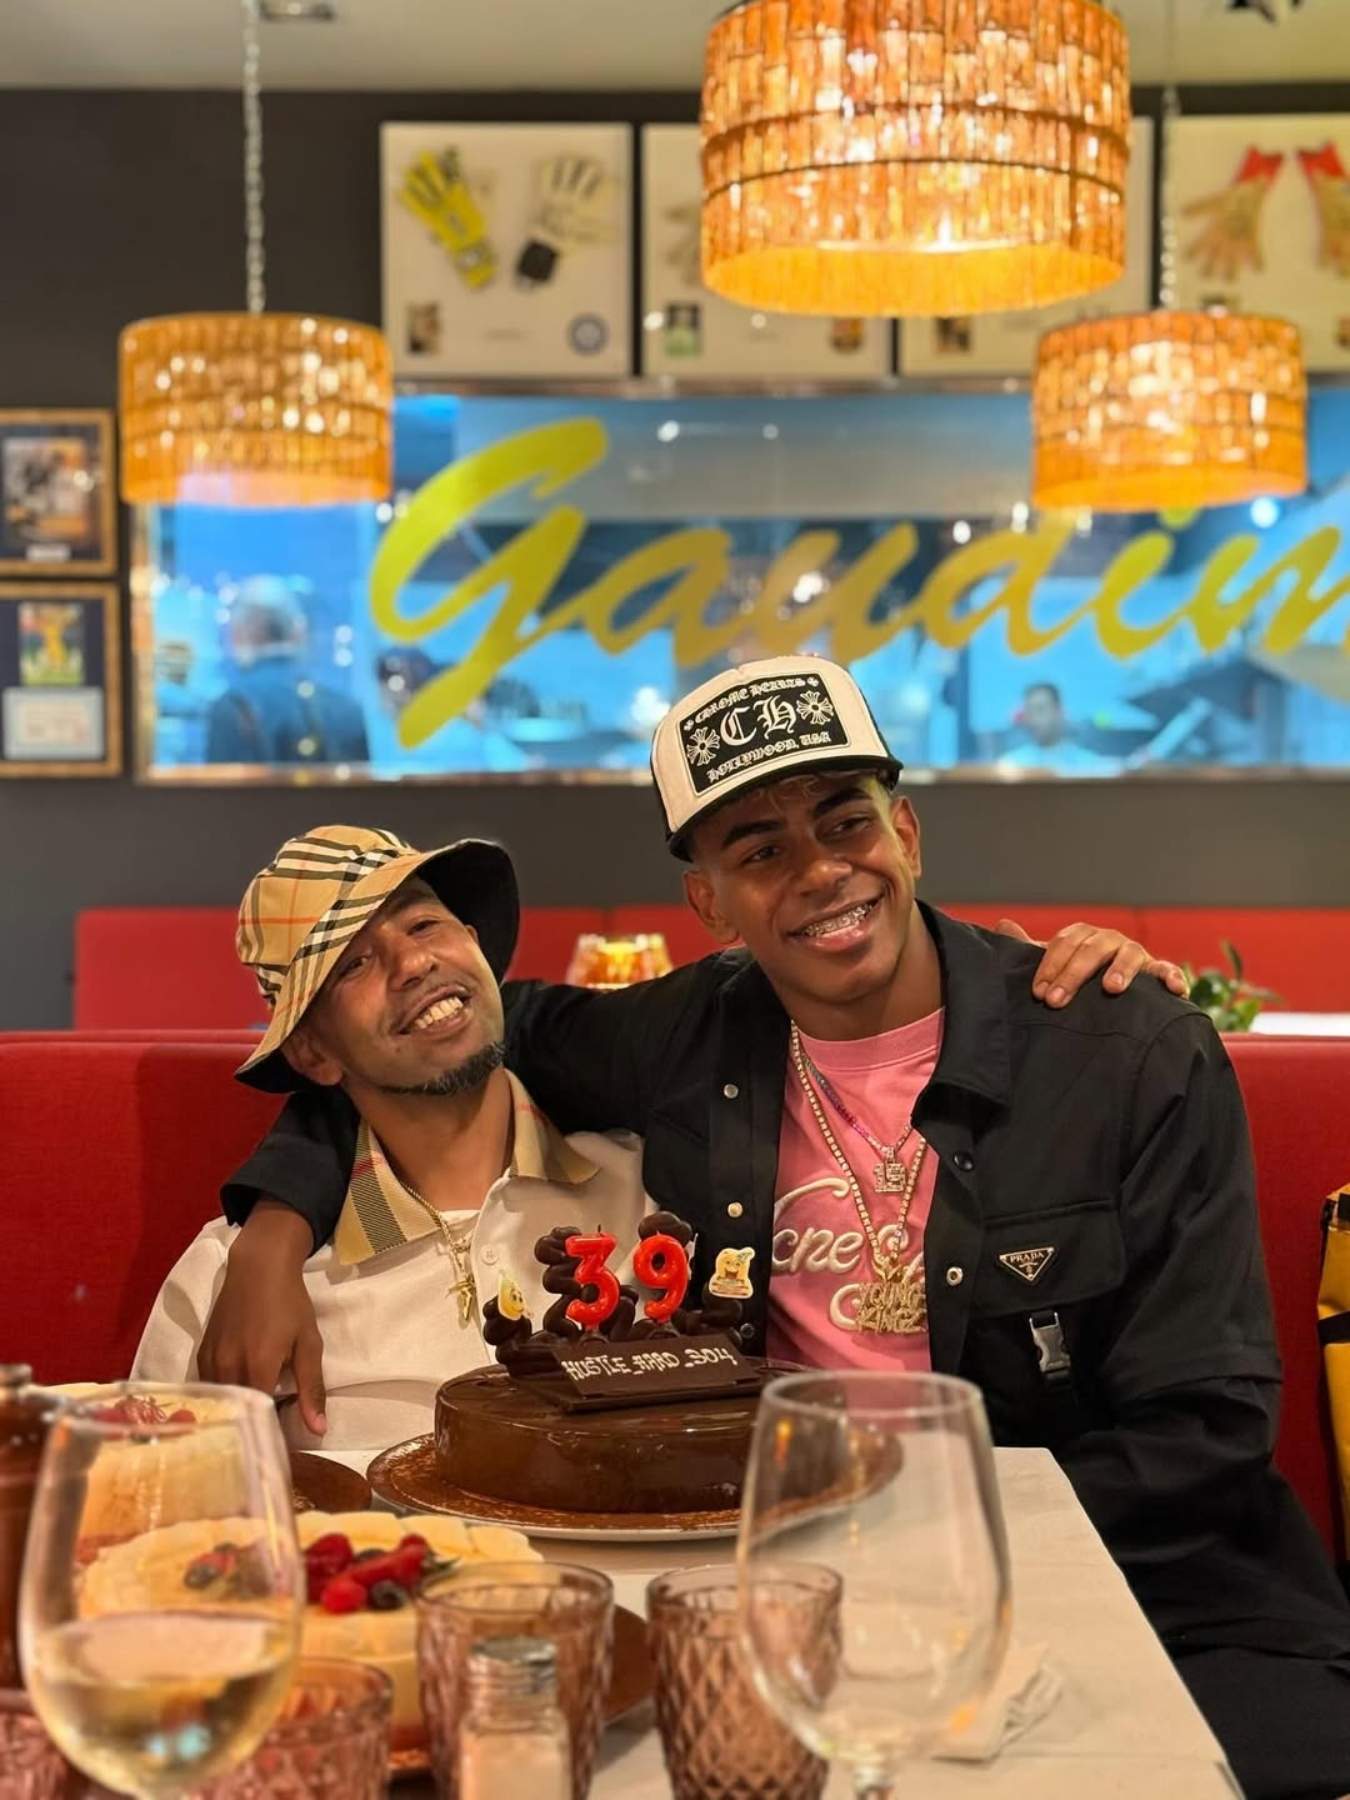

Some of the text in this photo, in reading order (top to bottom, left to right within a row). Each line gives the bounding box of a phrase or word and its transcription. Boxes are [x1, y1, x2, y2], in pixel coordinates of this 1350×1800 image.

[693, 677, 806, 724] CHROME HEARTS
[719, 694, 797, 747] CH
[565, 1232, 688, 1328] 39
[1010, 1251, 1045, 1263] PRADA
